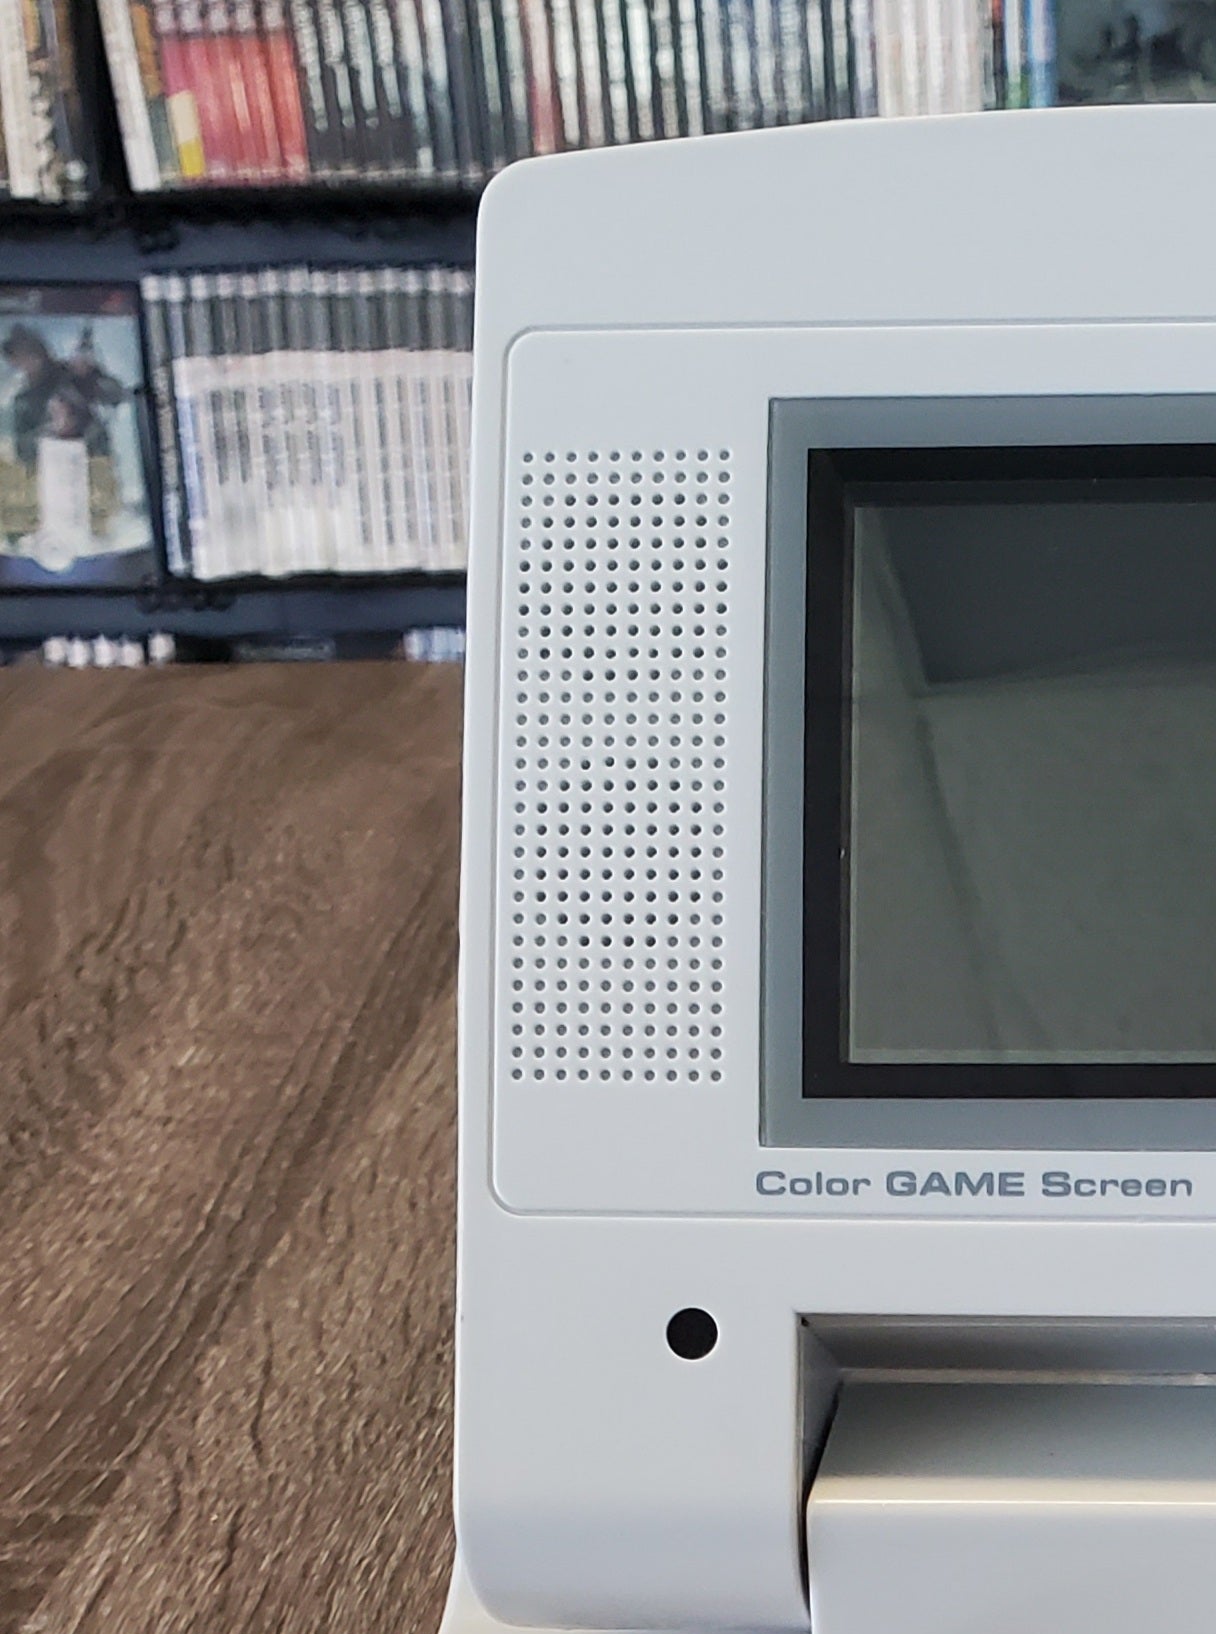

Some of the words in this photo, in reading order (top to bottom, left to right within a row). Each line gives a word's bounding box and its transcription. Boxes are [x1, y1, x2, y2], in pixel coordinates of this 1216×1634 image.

[755, 1170, 872, 1197] Color
[885, 1170, 1025, 1197] GAME
[1041, 1171, 1193, 1197] Screen
